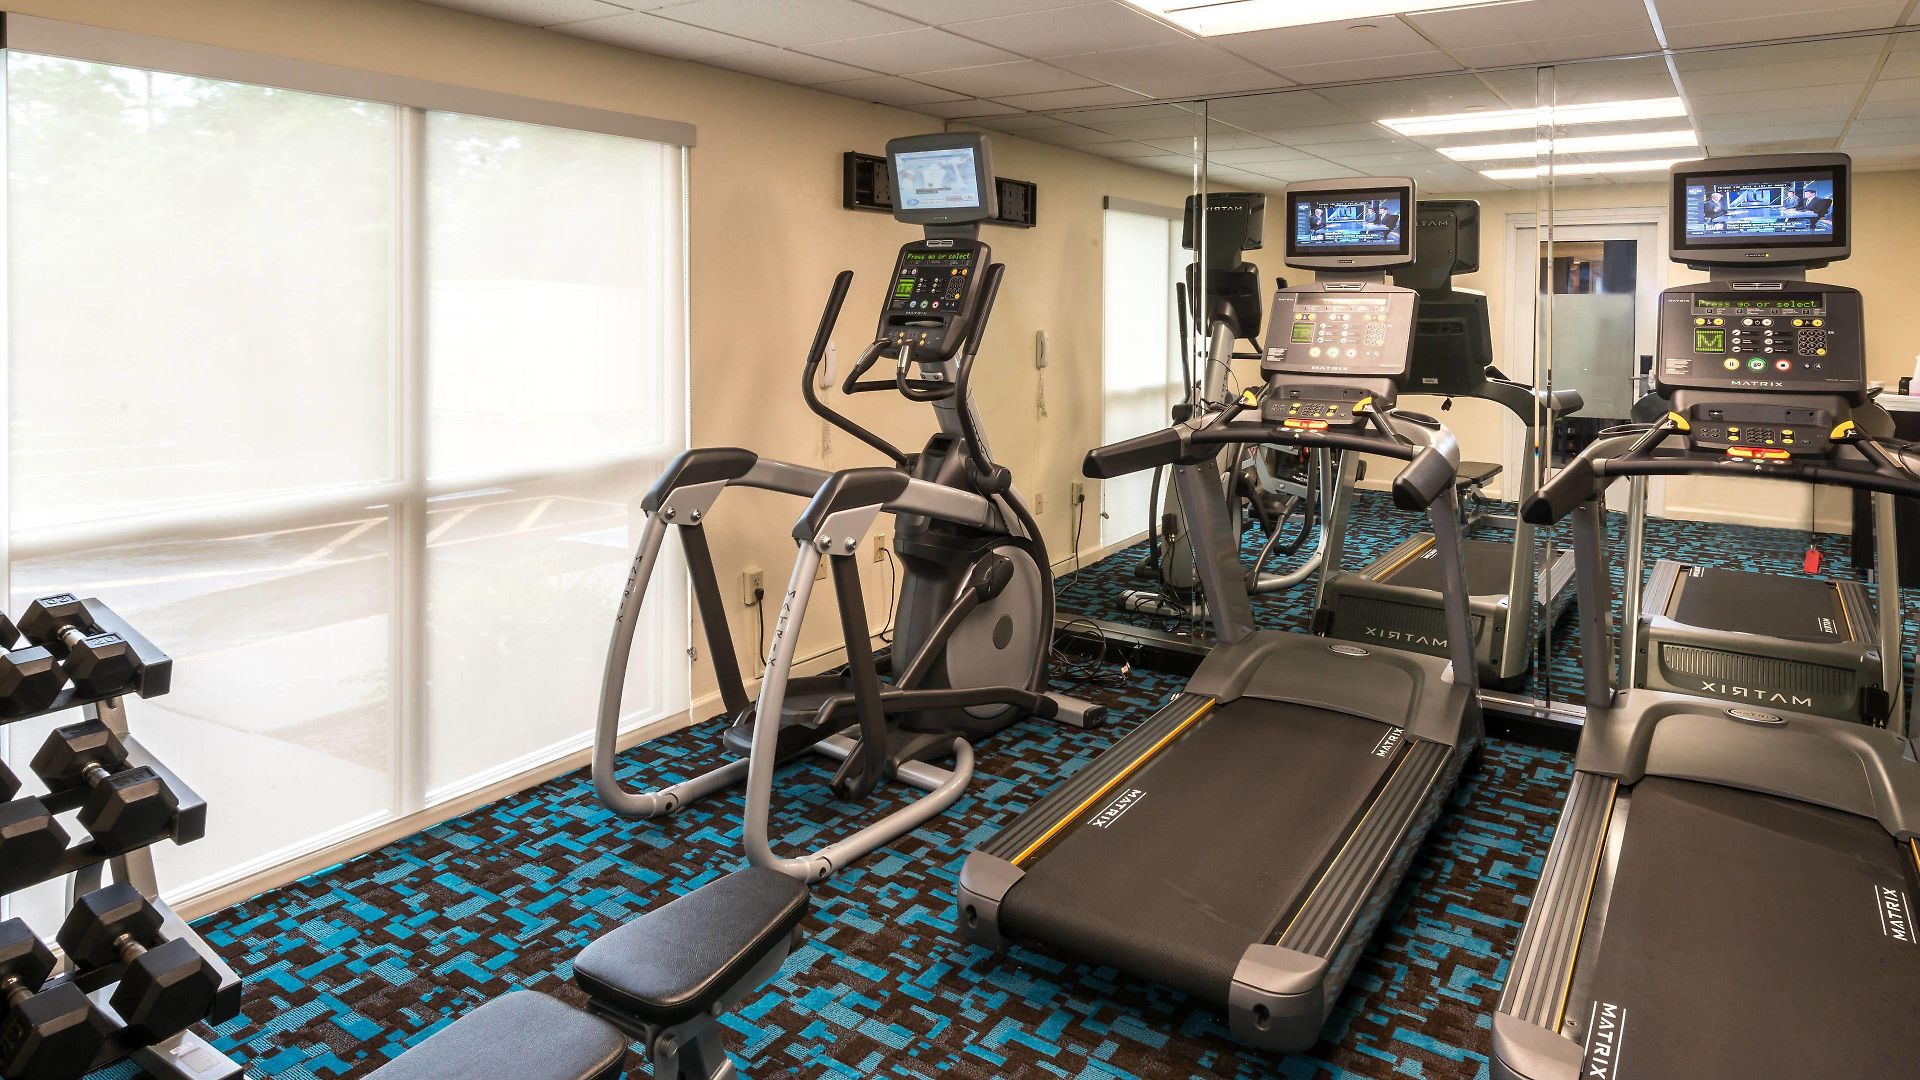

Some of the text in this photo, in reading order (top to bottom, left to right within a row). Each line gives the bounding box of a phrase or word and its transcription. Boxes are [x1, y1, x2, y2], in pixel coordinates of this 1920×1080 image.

[948, 252, 971, 260] select
[1698, 299, 1730, 307] Press
[1776, 299, 1817, 307] select
[768, 590, 796, 667] MATRIX
[1376, 727, 1404, 758] MATRIX
[1092, 789, 1142, 827] MATRIX
[1882, 886, 1908, 942] MATRIX
[1589, 1002, 1618, 1080] MATRIX
